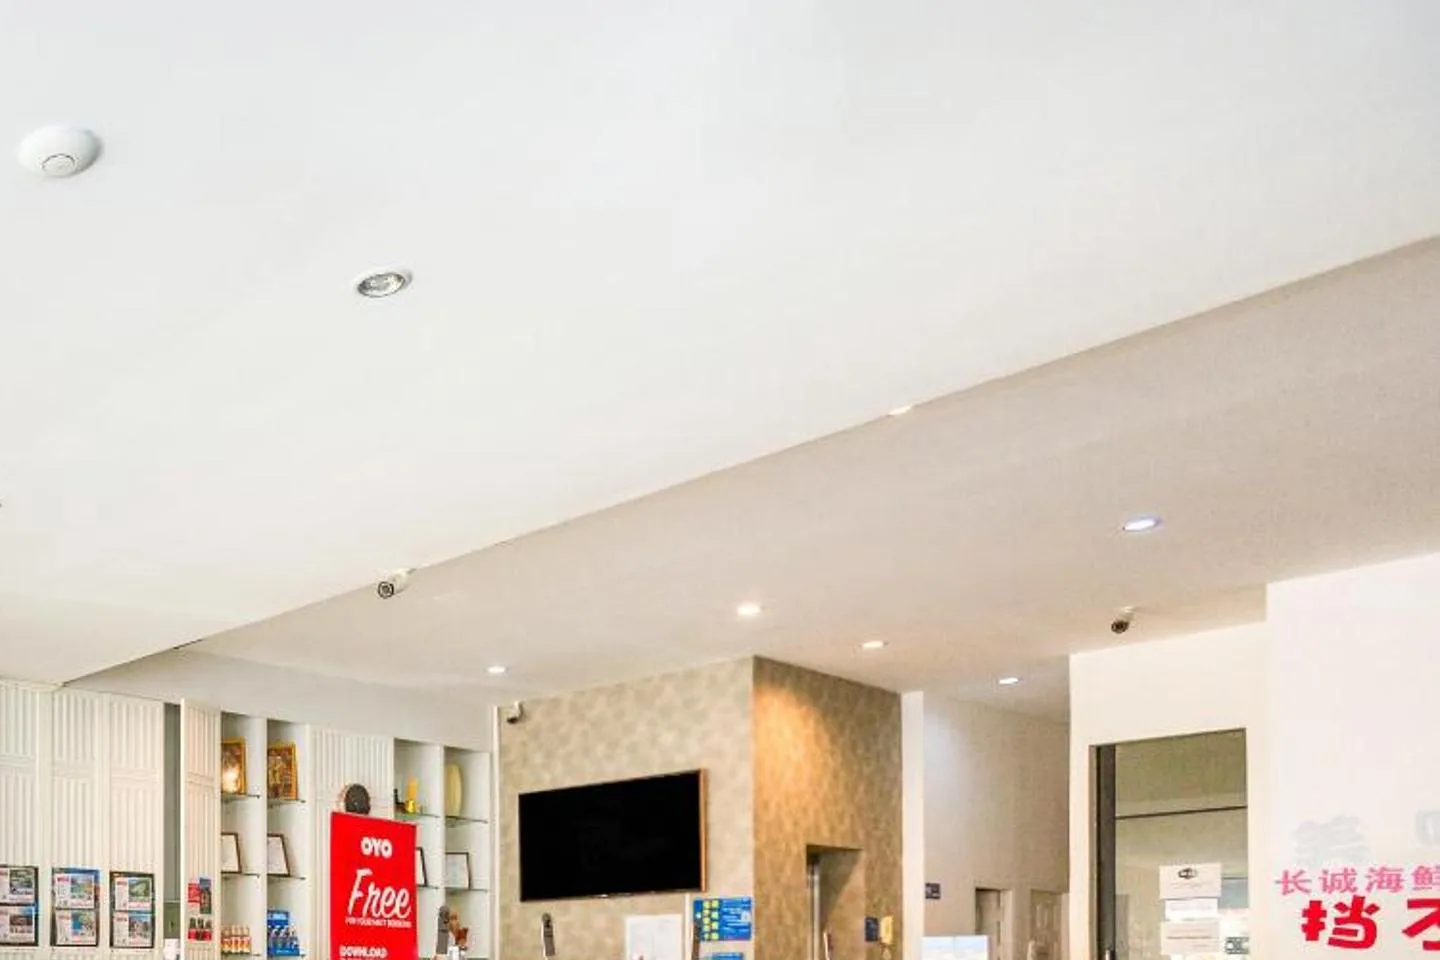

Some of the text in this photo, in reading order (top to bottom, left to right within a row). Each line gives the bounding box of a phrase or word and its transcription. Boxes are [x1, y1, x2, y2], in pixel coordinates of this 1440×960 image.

[361, 836, 393, 858] OYO
[347, 868, 412, 919] Free
[339, 945, 388, 959] DOWNLOAD
